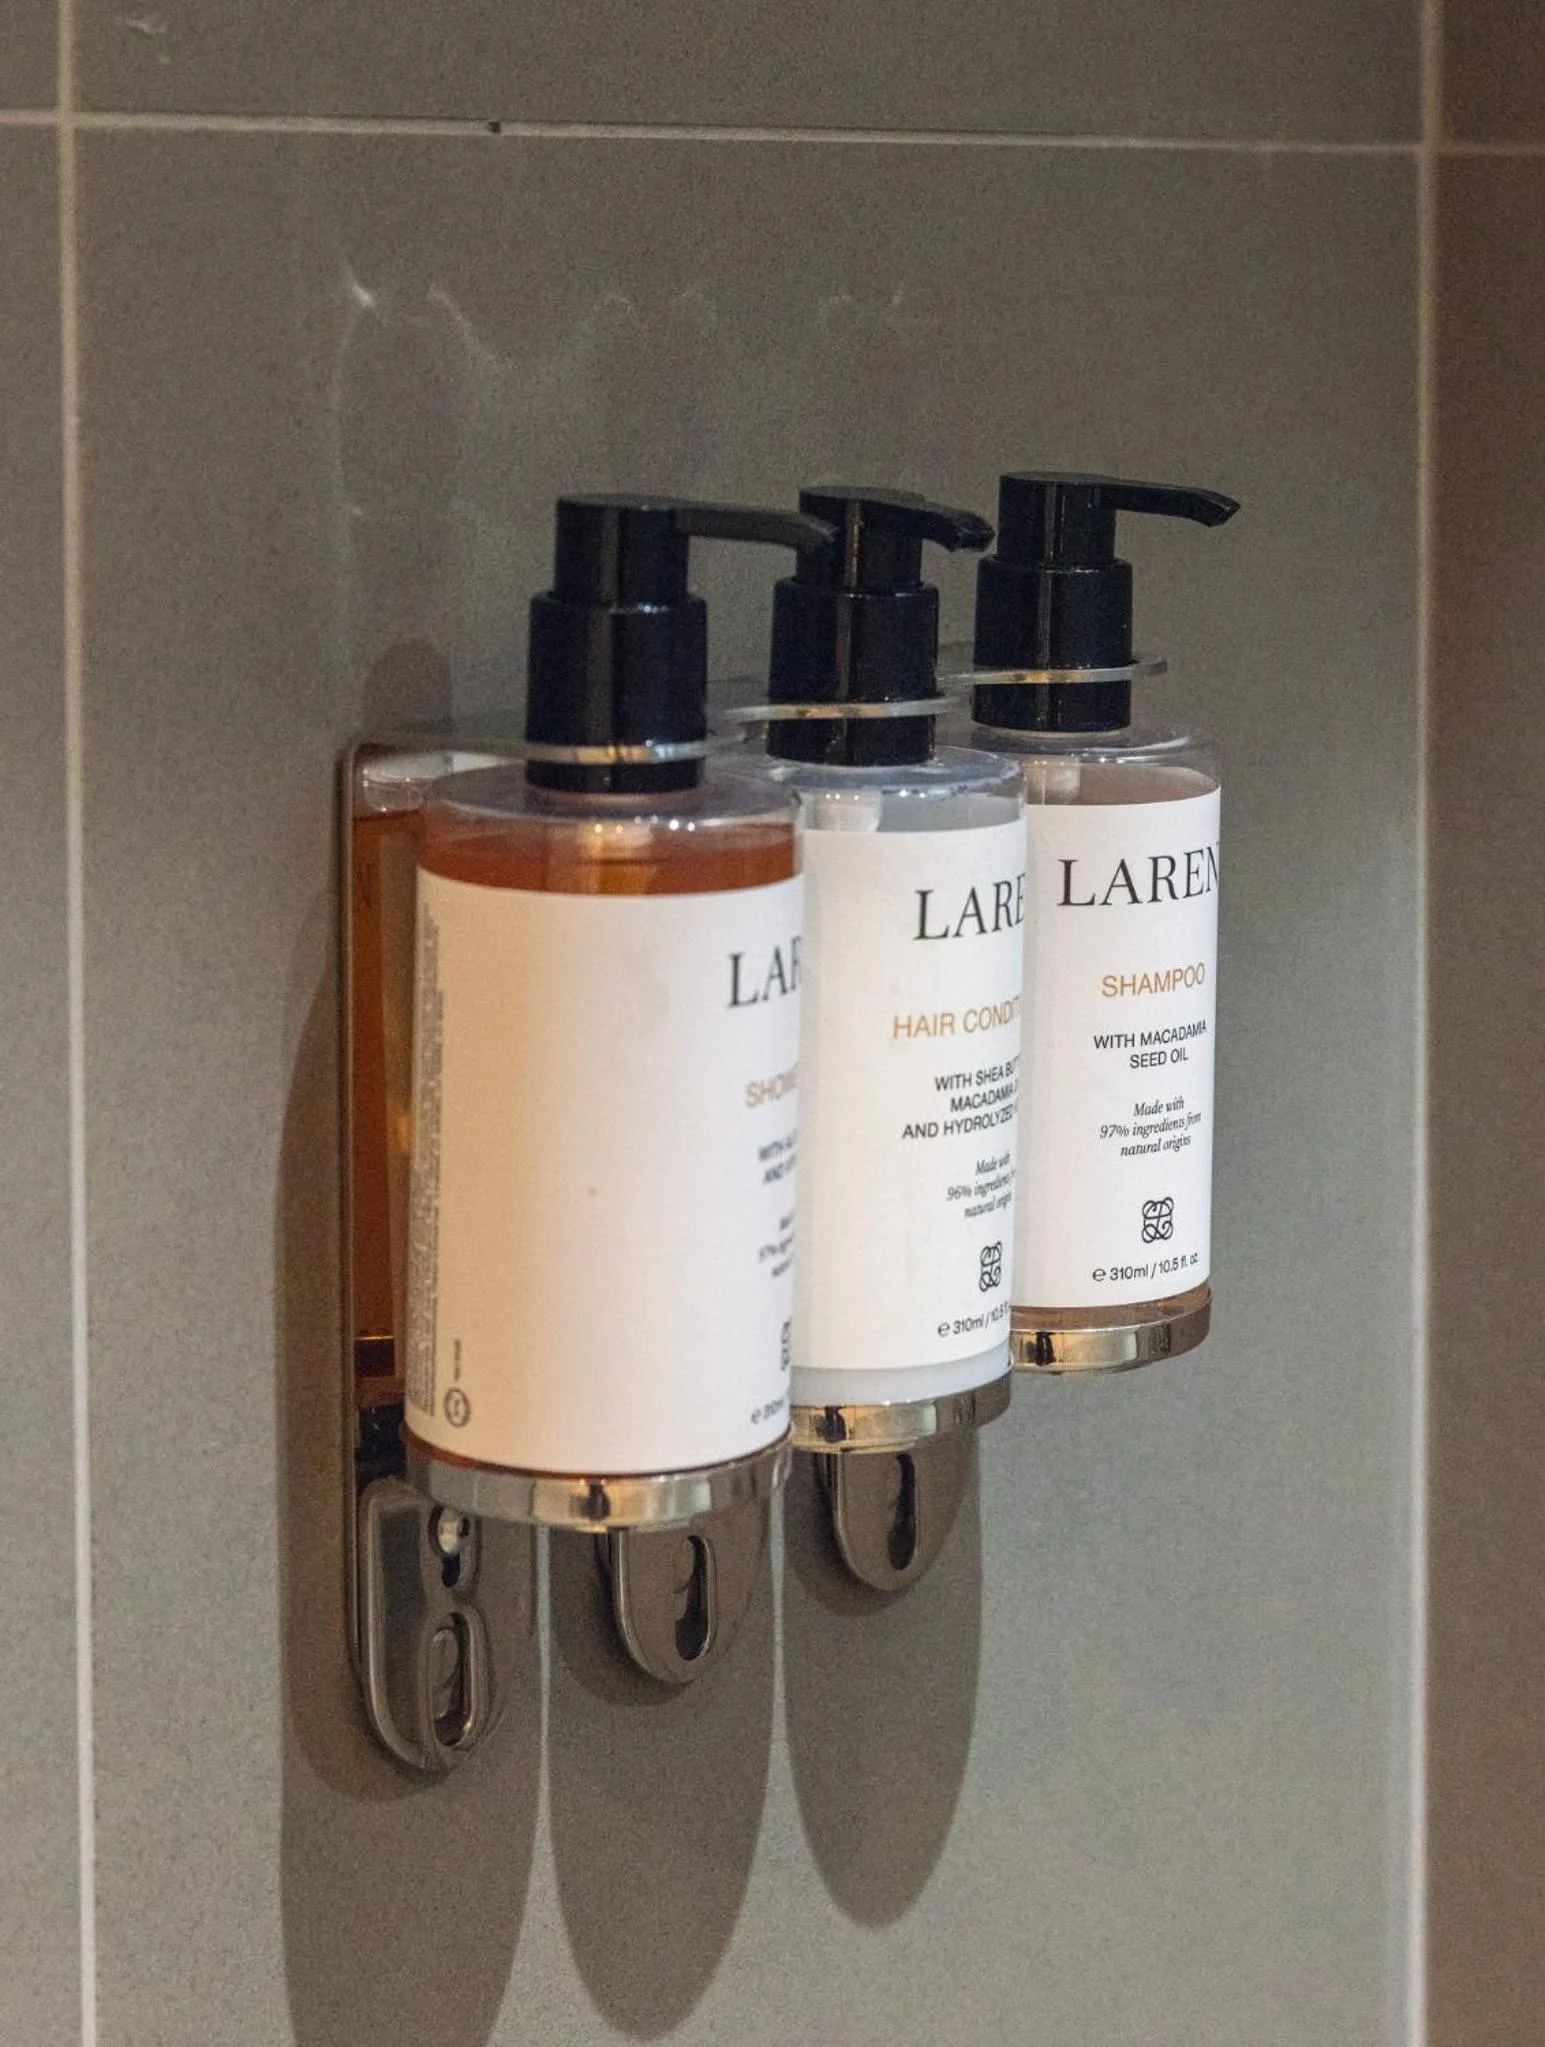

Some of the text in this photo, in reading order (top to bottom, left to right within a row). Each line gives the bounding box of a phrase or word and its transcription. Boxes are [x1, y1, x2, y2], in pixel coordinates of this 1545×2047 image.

[1057, 845, 1219, 906] LAREN
[1101, 962, 1206, 998] SHAMPOO
[893, 1012, 955, 1039] HAIR
[1093, 1019, 1207, 1049] WITH MACADAMIA
[1130, 1046, 1189, 1069] SEED OIL
[935, 1073, 972, 1091] WITH
[975, 1065, 1004, 1087] SHEA
[1133, 1095, 1185, 1117] Made with
[902, 1122, 939, 1140] AND
[1099, 1111, 1202, 1139] 97% ingredients from
[1120, 1133, 1192, 1156] natural origins
[1109, 1264, 1148, 1282] 310ml
[1158, 1257, 1179, 1274] 10.5
[953, 1313, 984, 1335] 310ml
